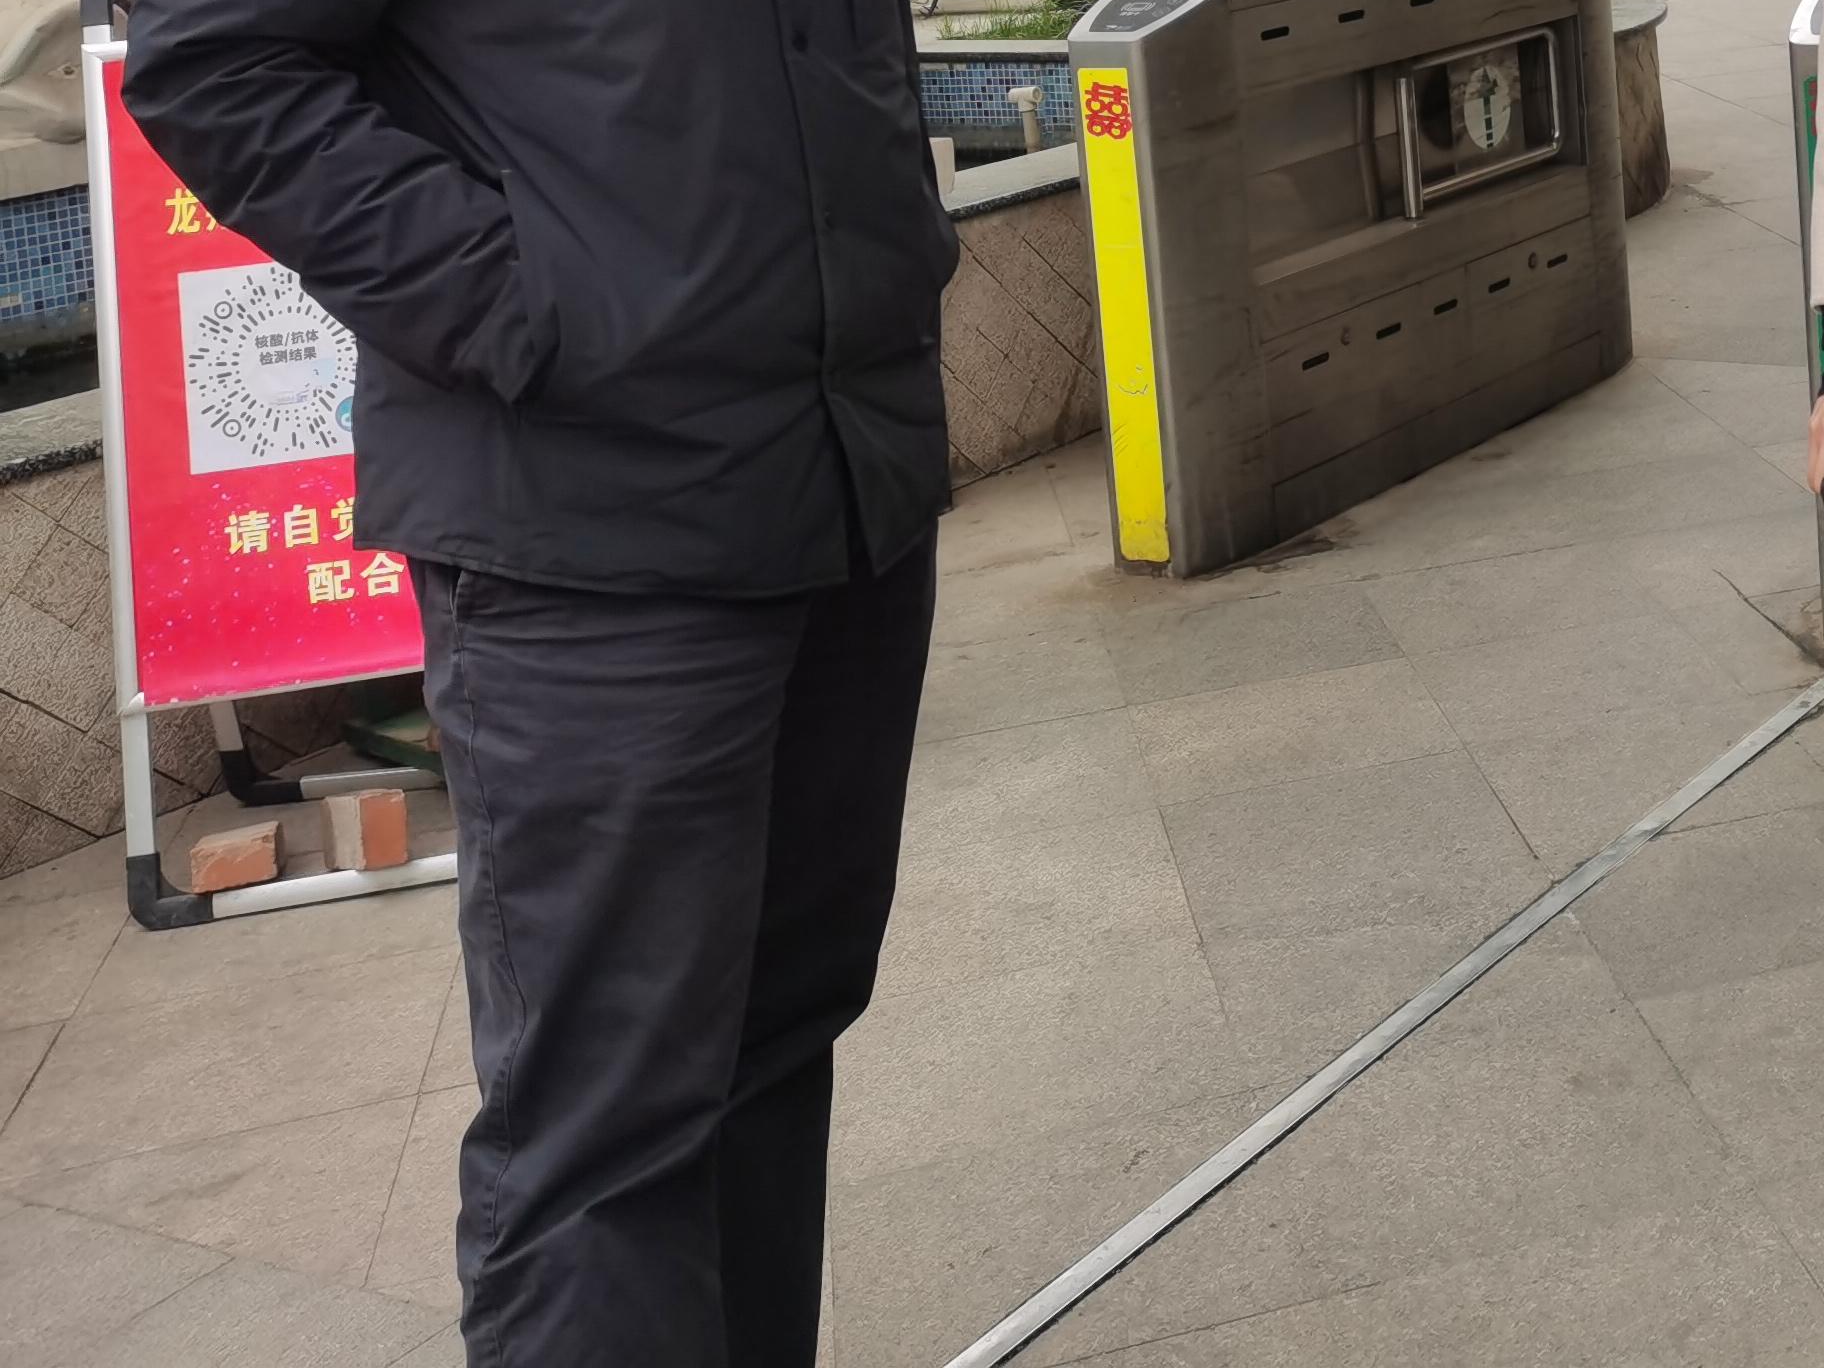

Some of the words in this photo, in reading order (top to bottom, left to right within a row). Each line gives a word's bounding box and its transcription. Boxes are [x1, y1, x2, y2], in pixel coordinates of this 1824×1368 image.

[165, 187, 218, 235] 龙
[254, 329, 320, 350] 核酸/抗体
[259, 346, 318, 366] 检测结果
[306, 552, 405, 604] 配合
